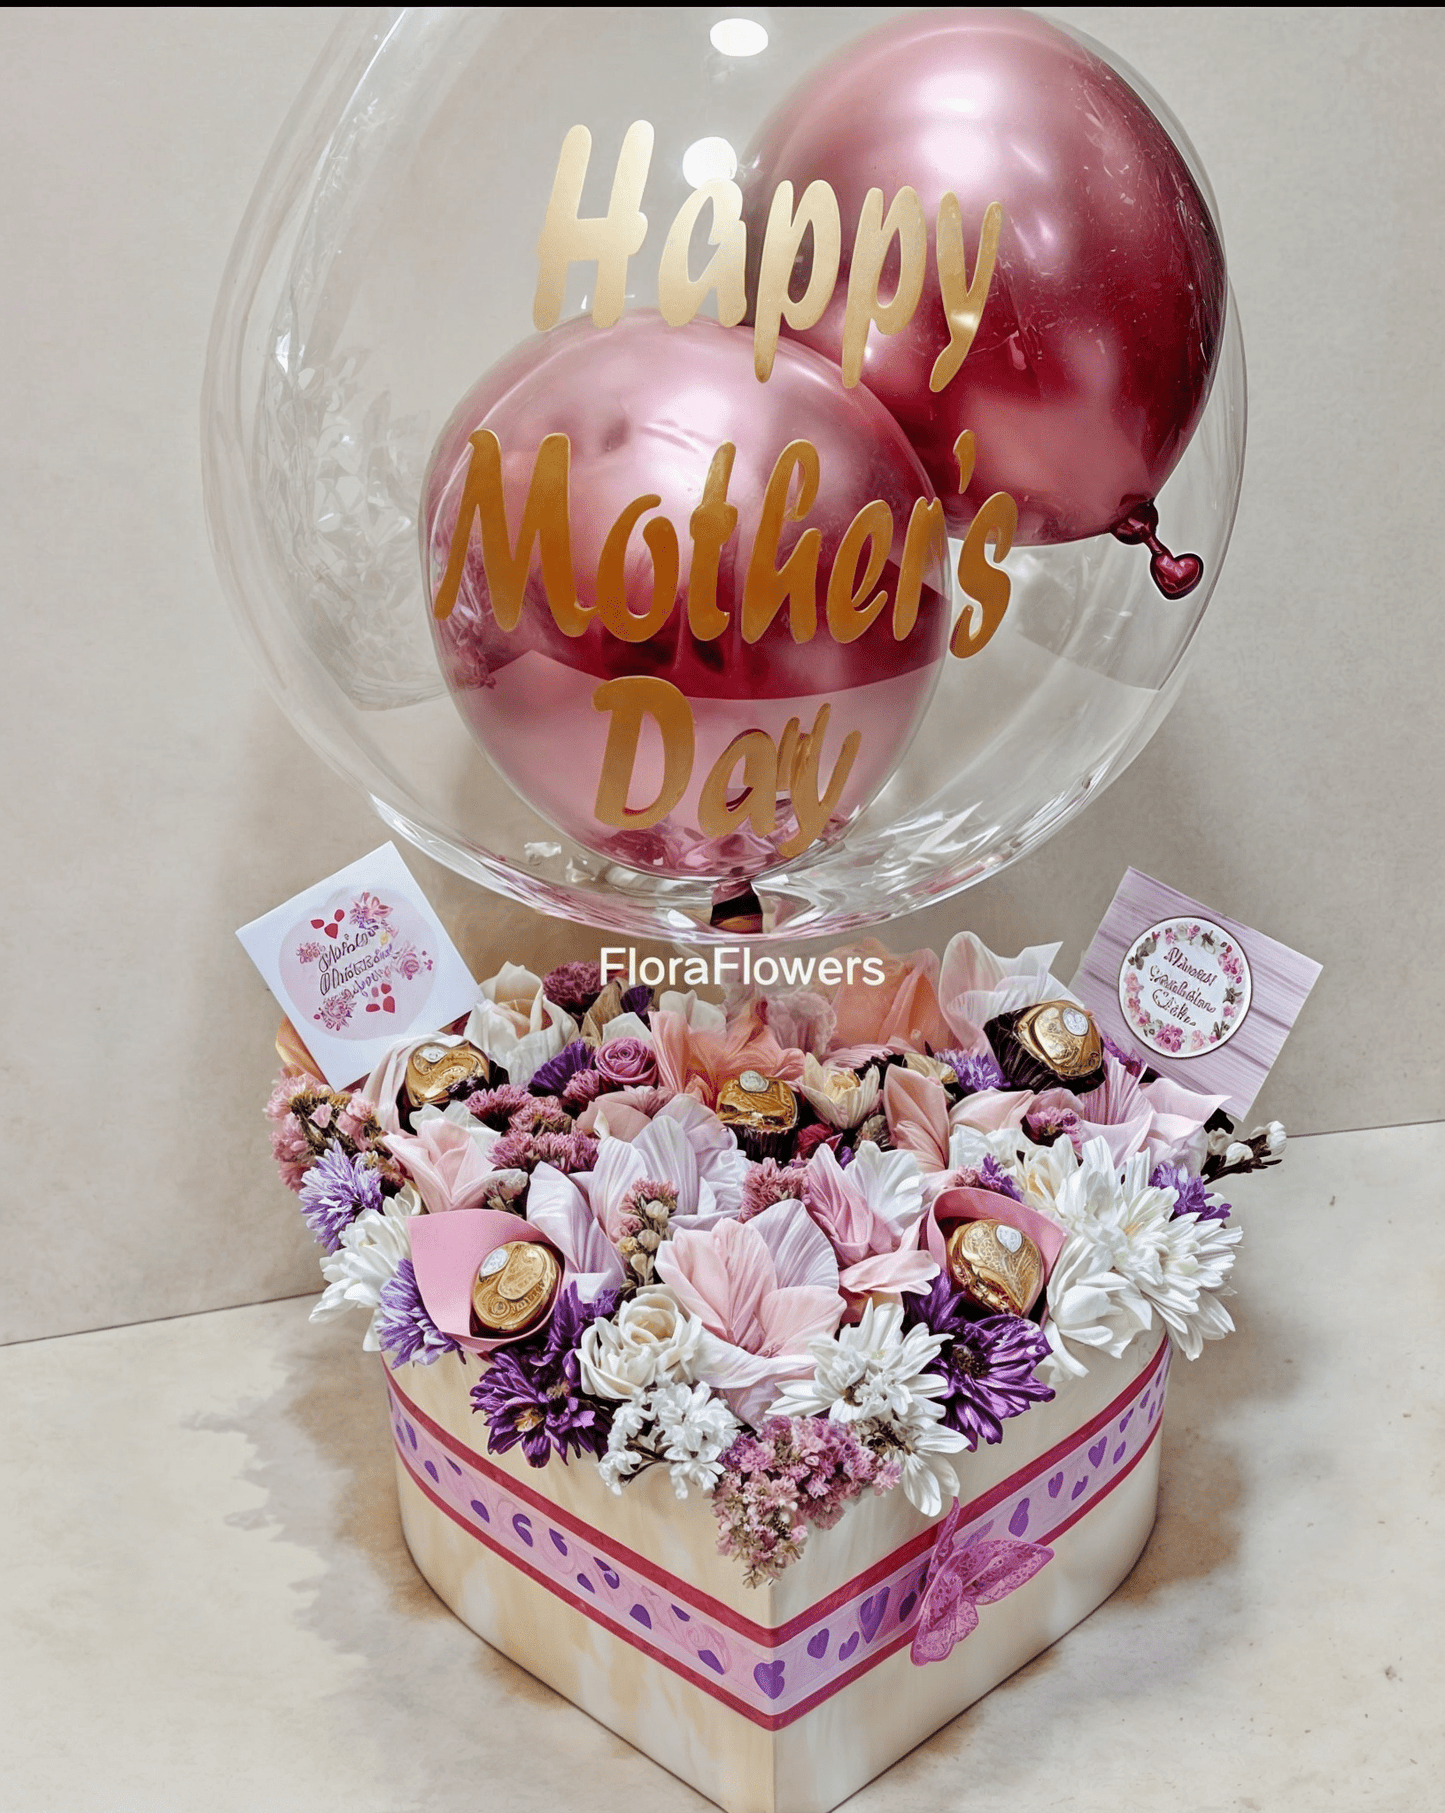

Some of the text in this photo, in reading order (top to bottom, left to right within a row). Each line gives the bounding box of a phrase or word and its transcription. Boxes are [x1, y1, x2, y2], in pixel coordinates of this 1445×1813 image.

[532, 120, 1003, 392] Happy
[434, 429, 1018, 659] Mother's
[592, 675, 862, 858] Day
